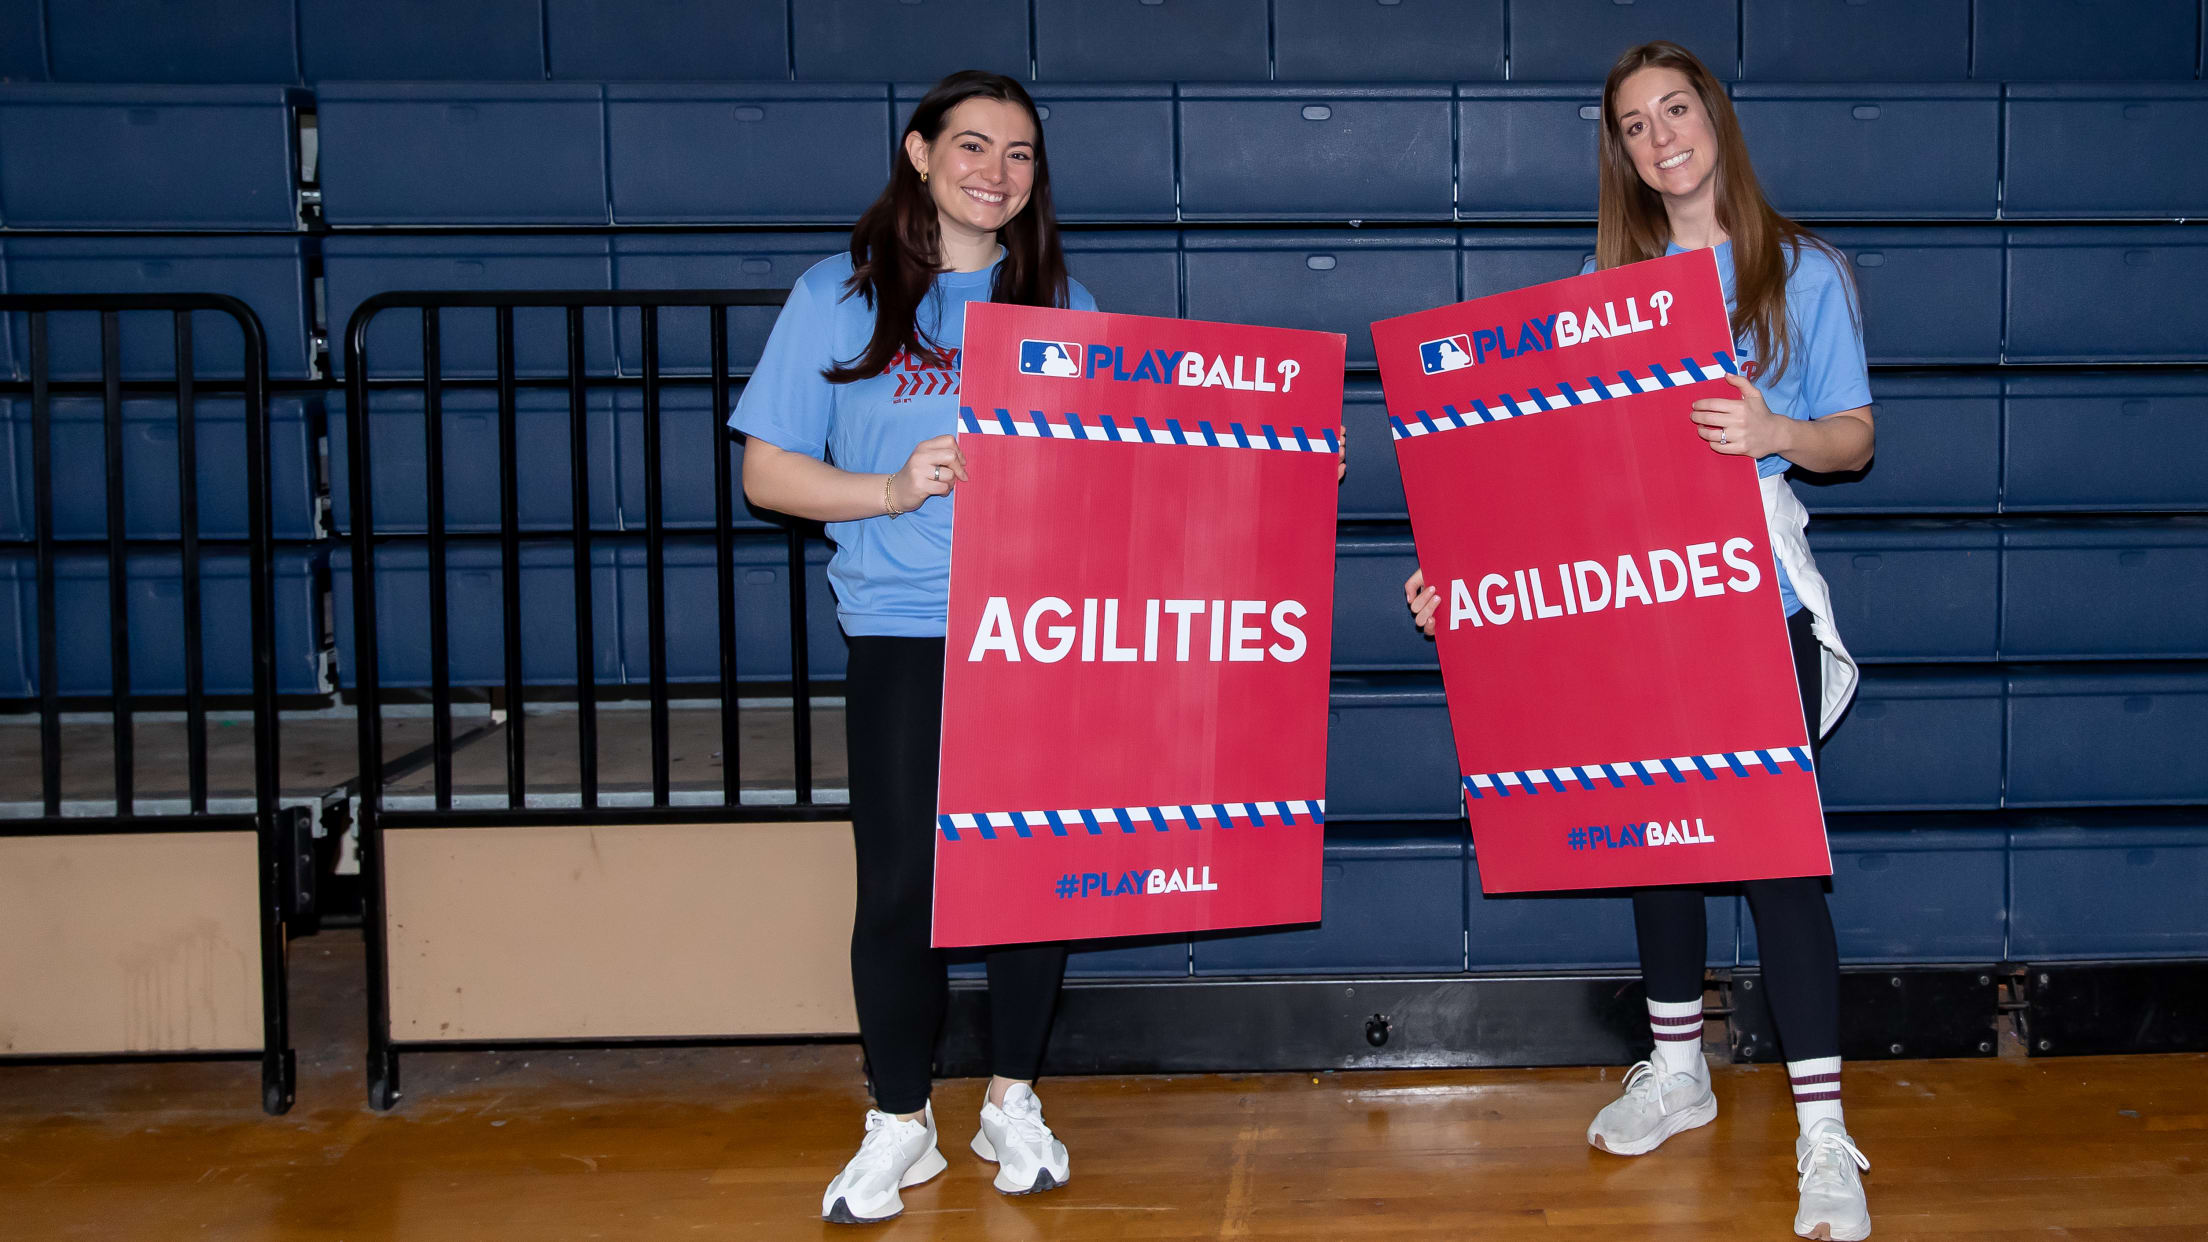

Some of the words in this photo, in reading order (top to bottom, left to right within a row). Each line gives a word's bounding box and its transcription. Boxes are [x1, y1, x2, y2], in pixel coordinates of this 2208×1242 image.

[1450, 537, 1760, 630] AGILIDADES
[968, 597, 1307, 663] AGILITIES
[1568, 818, 1714, 850] #PLAYBALL
[1055, 866, 1217, 899] #PLAYBALL
